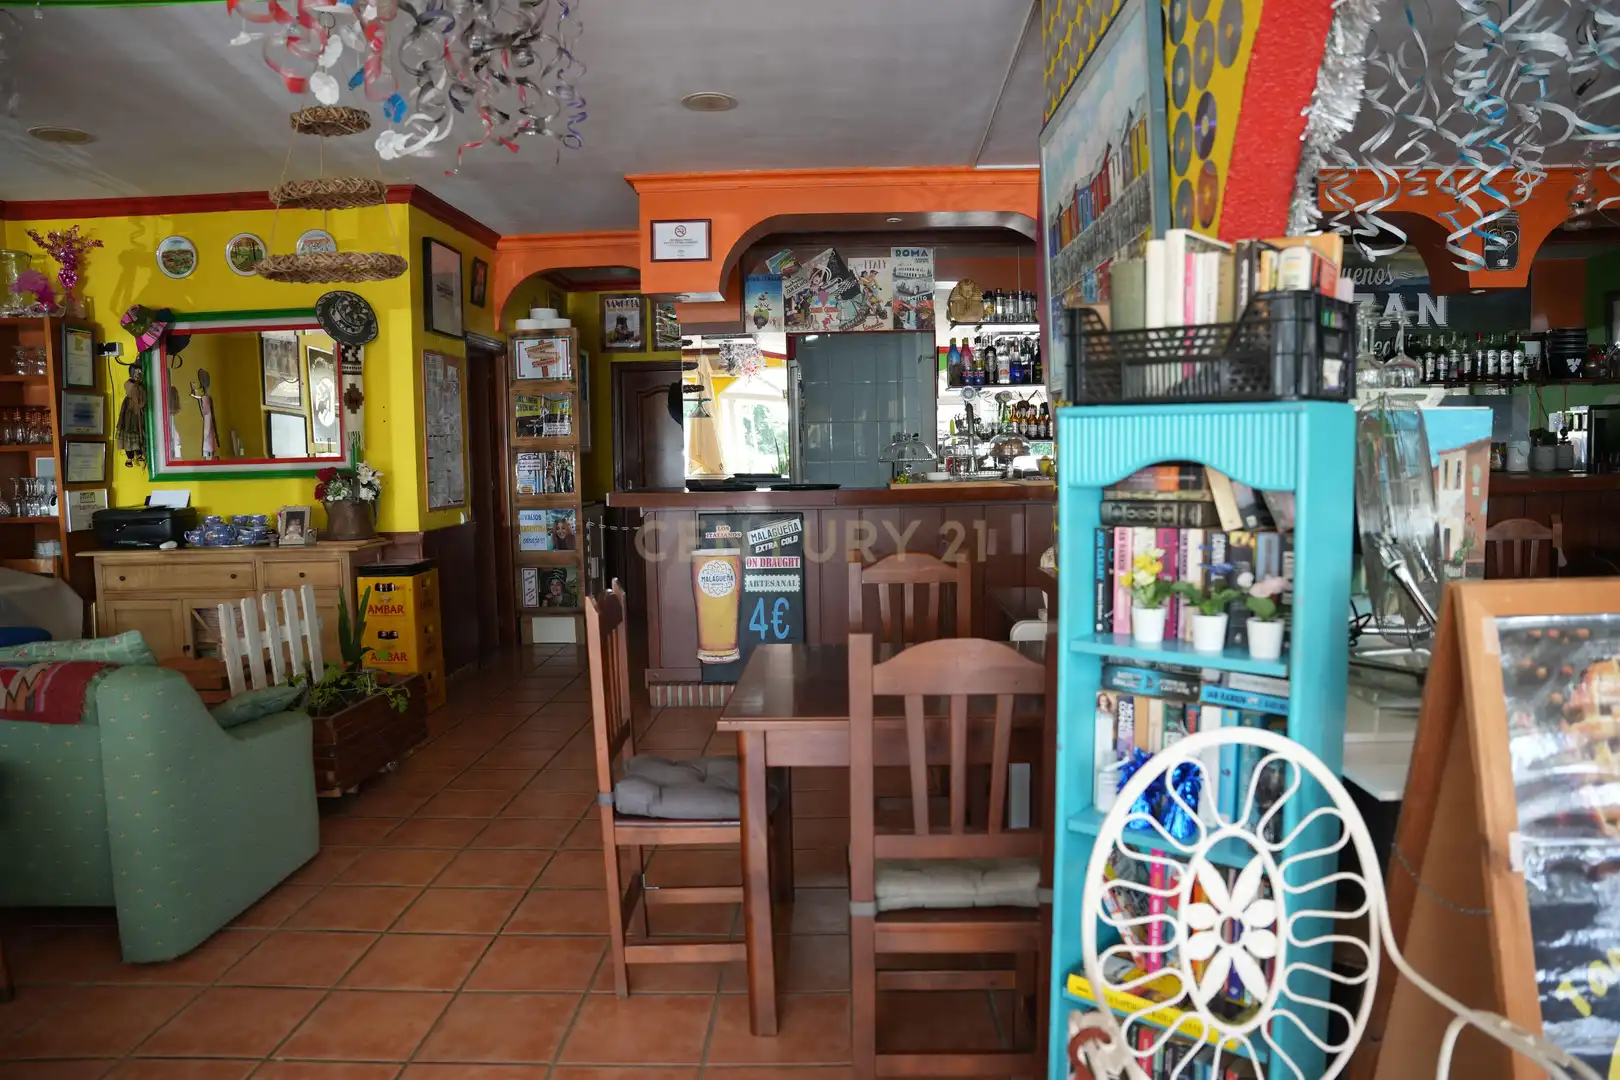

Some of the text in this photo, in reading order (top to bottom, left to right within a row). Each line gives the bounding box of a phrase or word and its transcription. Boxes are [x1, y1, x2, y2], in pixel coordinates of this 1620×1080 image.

[895, 249, 929, 257] ROMA
[864, 259, 887, 269] ITALY
[1342, 263, 1397, 286] uenos
[750, 521, 800, 543] MALAGUEÑA
[755, 535, 799, 553] EXTRA COLD
[746, 556, 800, 567] ON DRAUGHT
[701, 574, 734, 582] MALAGUEÑA
[748, 579, 798, 587] ARTESANAL
[368, 604, 405, 614] AMBAR
[749, 597, 790, 640] 4€
[370, 651, 408, 661] ABAR
